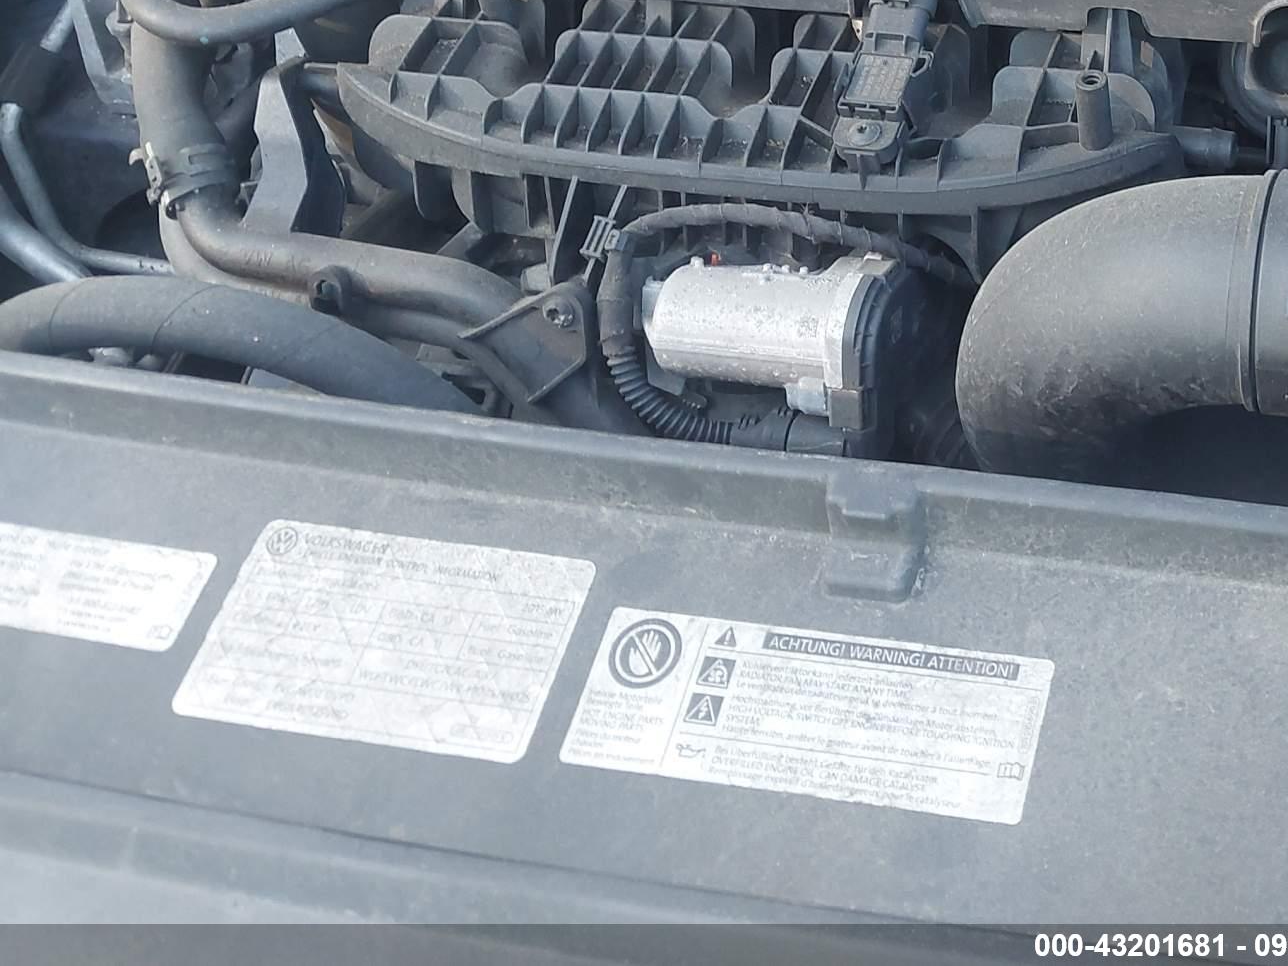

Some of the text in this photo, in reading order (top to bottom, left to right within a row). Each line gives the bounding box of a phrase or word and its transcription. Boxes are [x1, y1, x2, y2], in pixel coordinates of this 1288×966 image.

[769, 636, 1015, 678] ACHTUNG! WARNING! ATTENTION!
